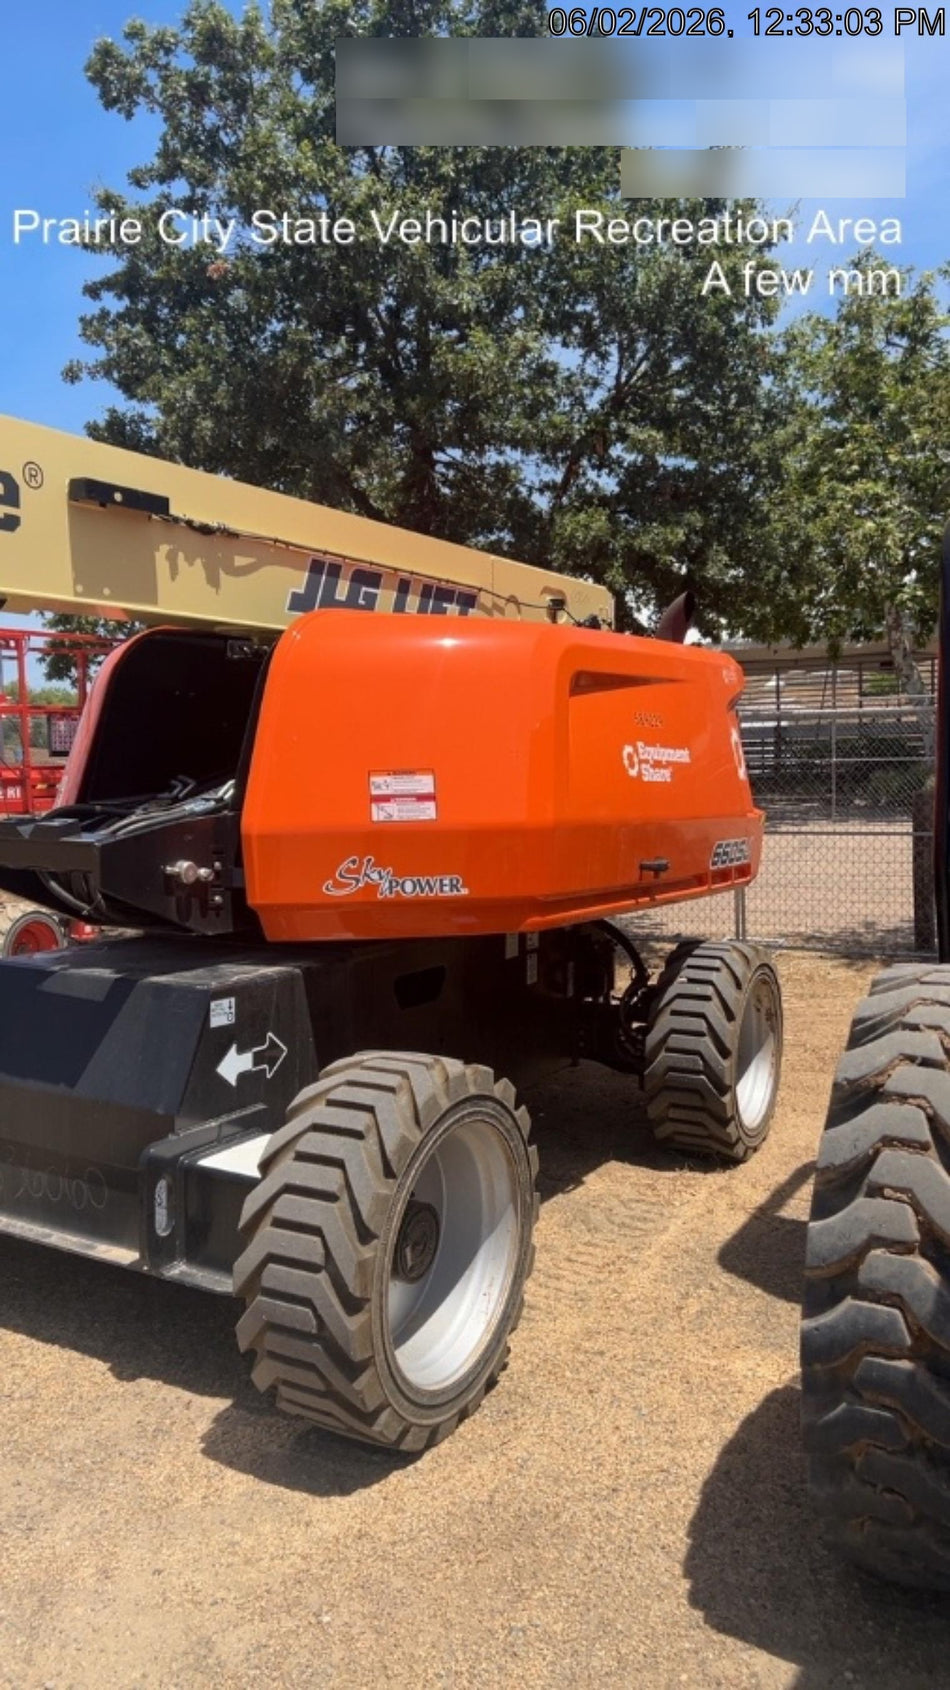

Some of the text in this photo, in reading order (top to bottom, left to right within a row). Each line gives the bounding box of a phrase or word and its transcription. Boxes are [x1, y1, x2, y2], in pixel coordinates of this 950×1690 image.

[287, 557, 383, 613] JLG
[636, 741, 691, 765] Equipment
[641, 764, 672, 782] Share
[323, 856, 393, 898] Sky
